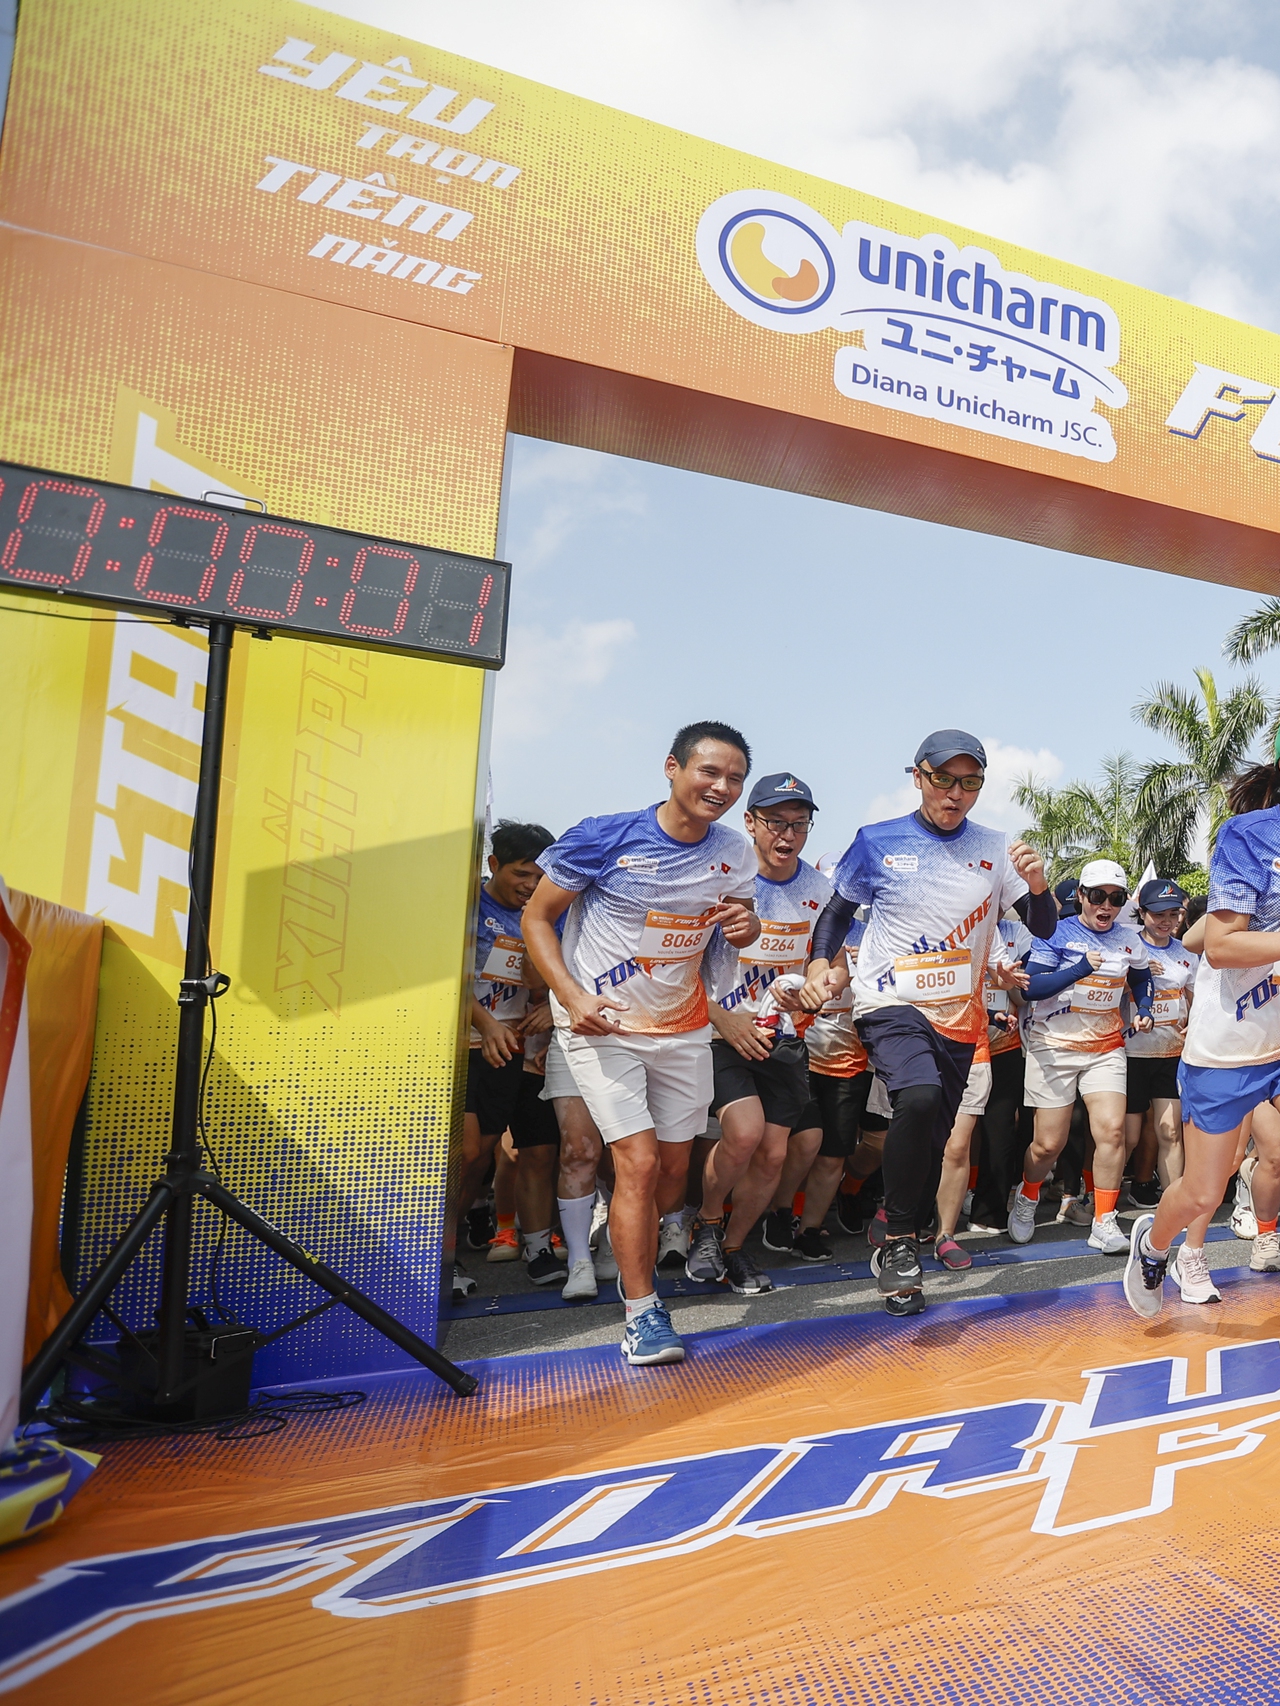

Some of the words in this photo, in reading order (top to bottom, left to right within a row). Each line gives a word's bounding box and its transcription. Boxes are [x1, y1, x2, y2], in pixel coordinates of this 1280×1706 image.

[258, 36, 496, 135] YÊU
[308, 232, 482, 295] NĂNG
[858, 237, 1106, 352] unicharm
[881, 317, 1081, 400] ユニ・チャーム
[851, 362, 928, 402] Diana
[936, 385, 1054, 435] Unicharm
[1060, 420, 1103, 448] JSC.
[662, 932, 703, 948] 8068
[760, 937, 795, 952] 8264
[916, 970, 956, 990] 8050
[1087, 989, 1113, 1002] 8276
[1151, 1003, 1170, 1015] 584
